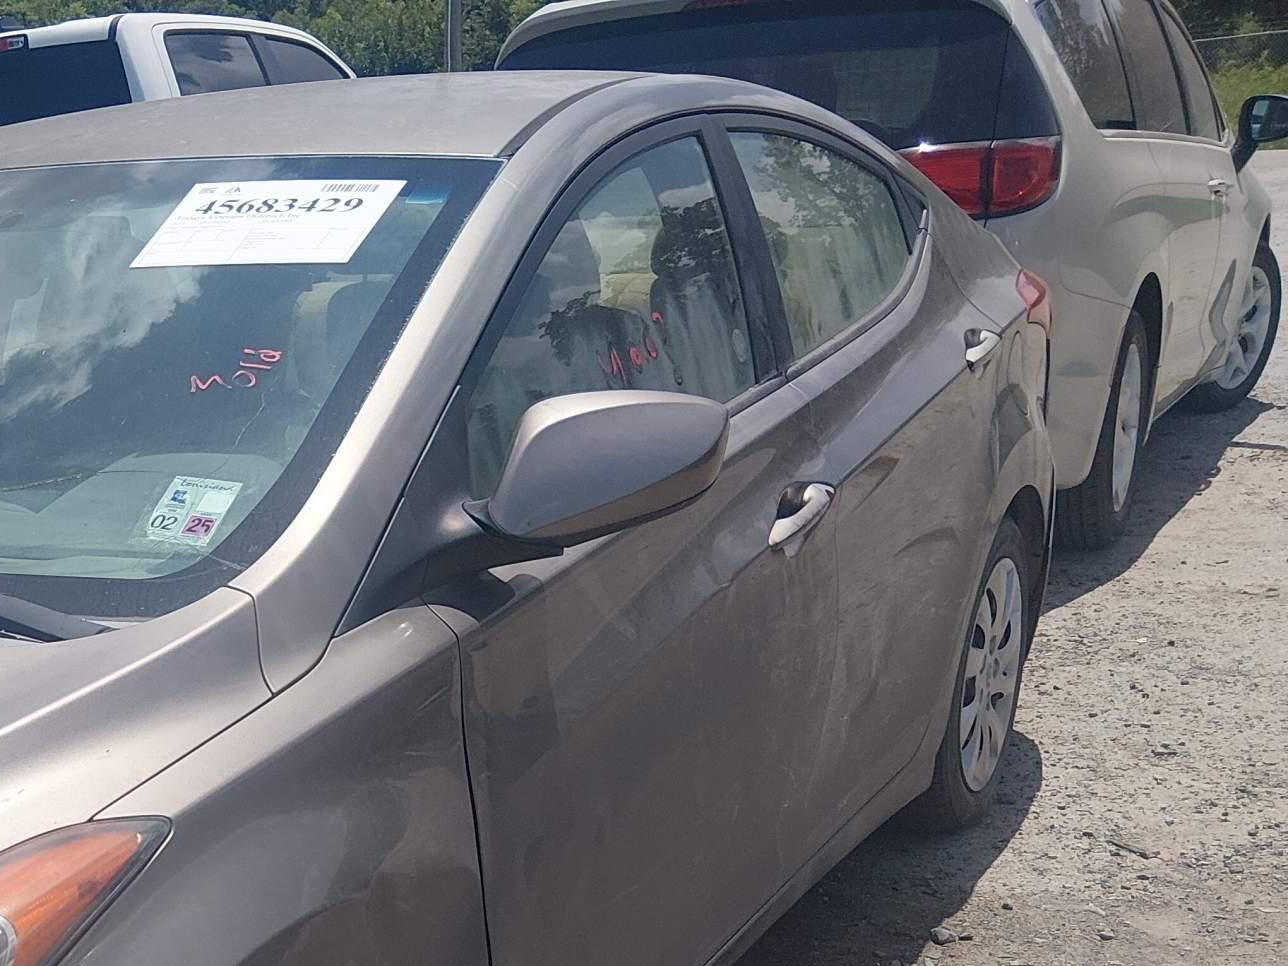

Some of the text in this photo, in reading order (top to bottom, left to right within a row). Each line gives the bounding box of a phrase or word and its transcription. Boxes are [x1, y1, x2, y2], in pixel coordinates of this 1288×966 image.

[195, 197, 364, 216] 45683429
[150, 514, 178, 531] 02
[185, 517, 214, 534] 25
